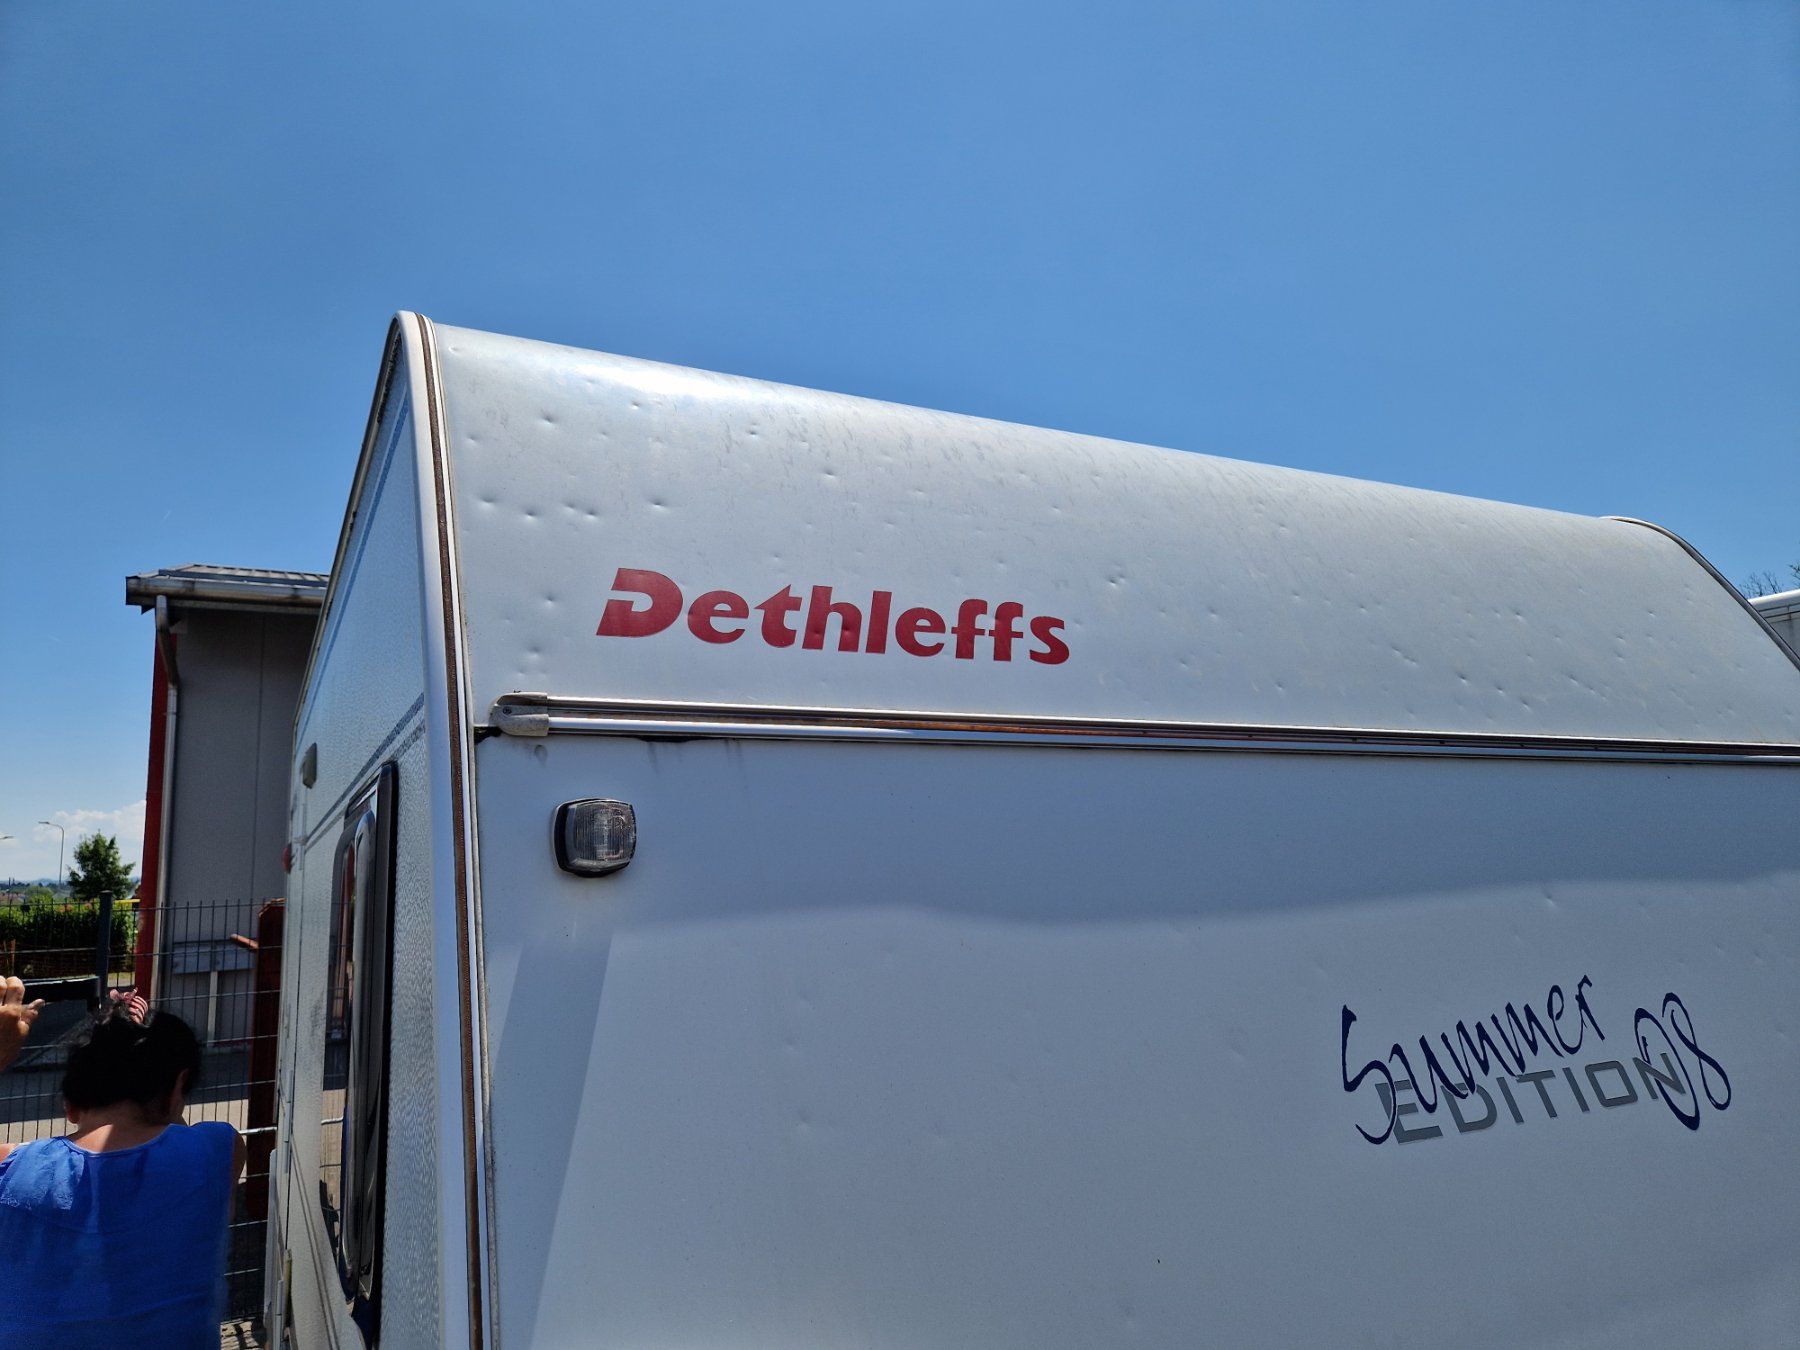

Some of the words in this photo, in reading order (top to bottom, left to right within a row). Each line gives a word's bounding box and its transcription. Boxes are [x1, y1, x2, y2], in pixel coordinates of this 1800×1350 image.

[596, 568, 1070, 665] Dethleffs
[1342, 975, 1605, 1145] Summer
[1375, 1052, 1686, 1144] EDITION
